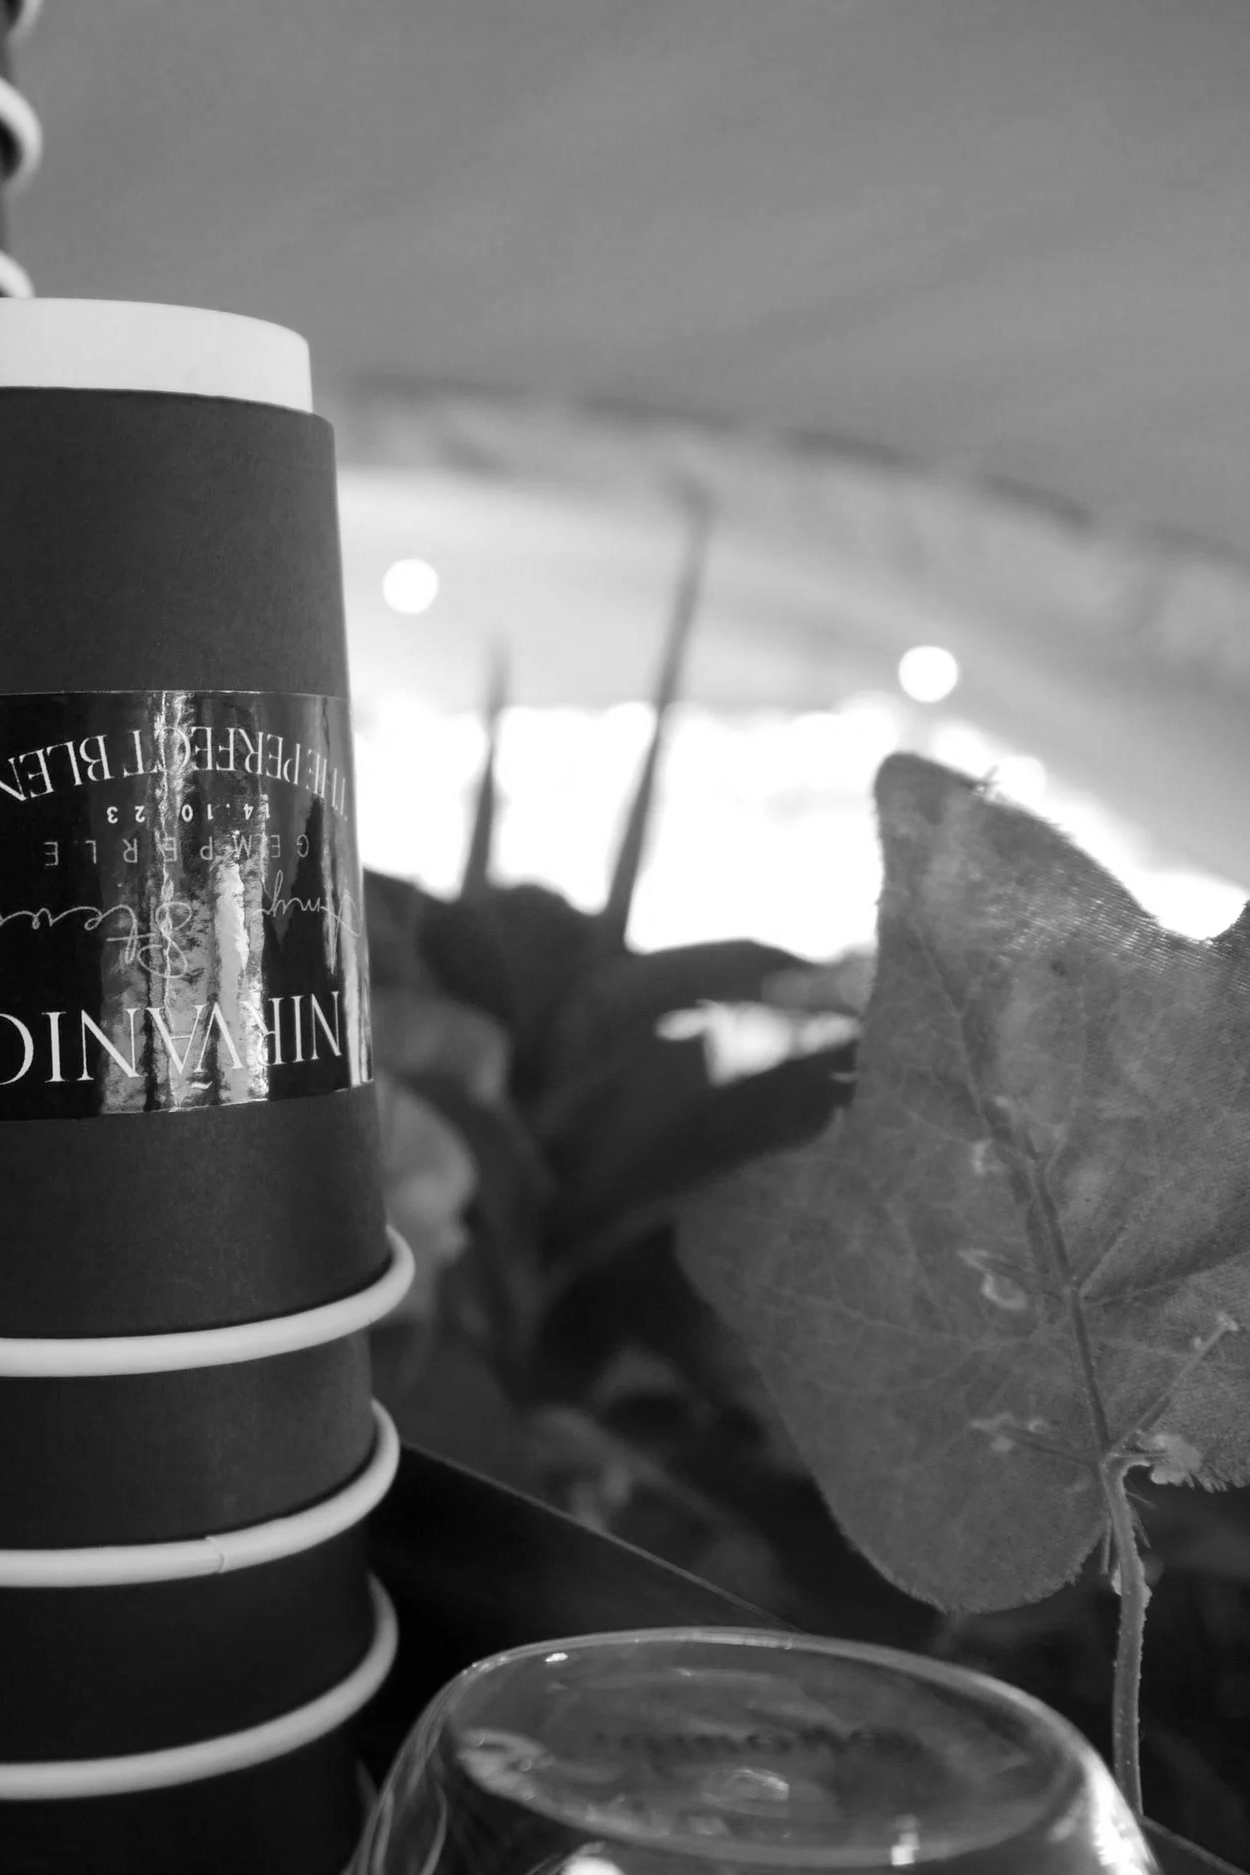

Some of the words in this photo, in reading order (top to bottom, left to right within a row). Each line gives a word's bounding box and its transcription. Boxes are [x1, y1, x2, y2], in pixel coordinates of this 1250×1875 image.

[123, 726, 301, 783] PERFECT
[304, 748, 347, 821] THE
[44, 834, 309, 867] GEMPERLE
